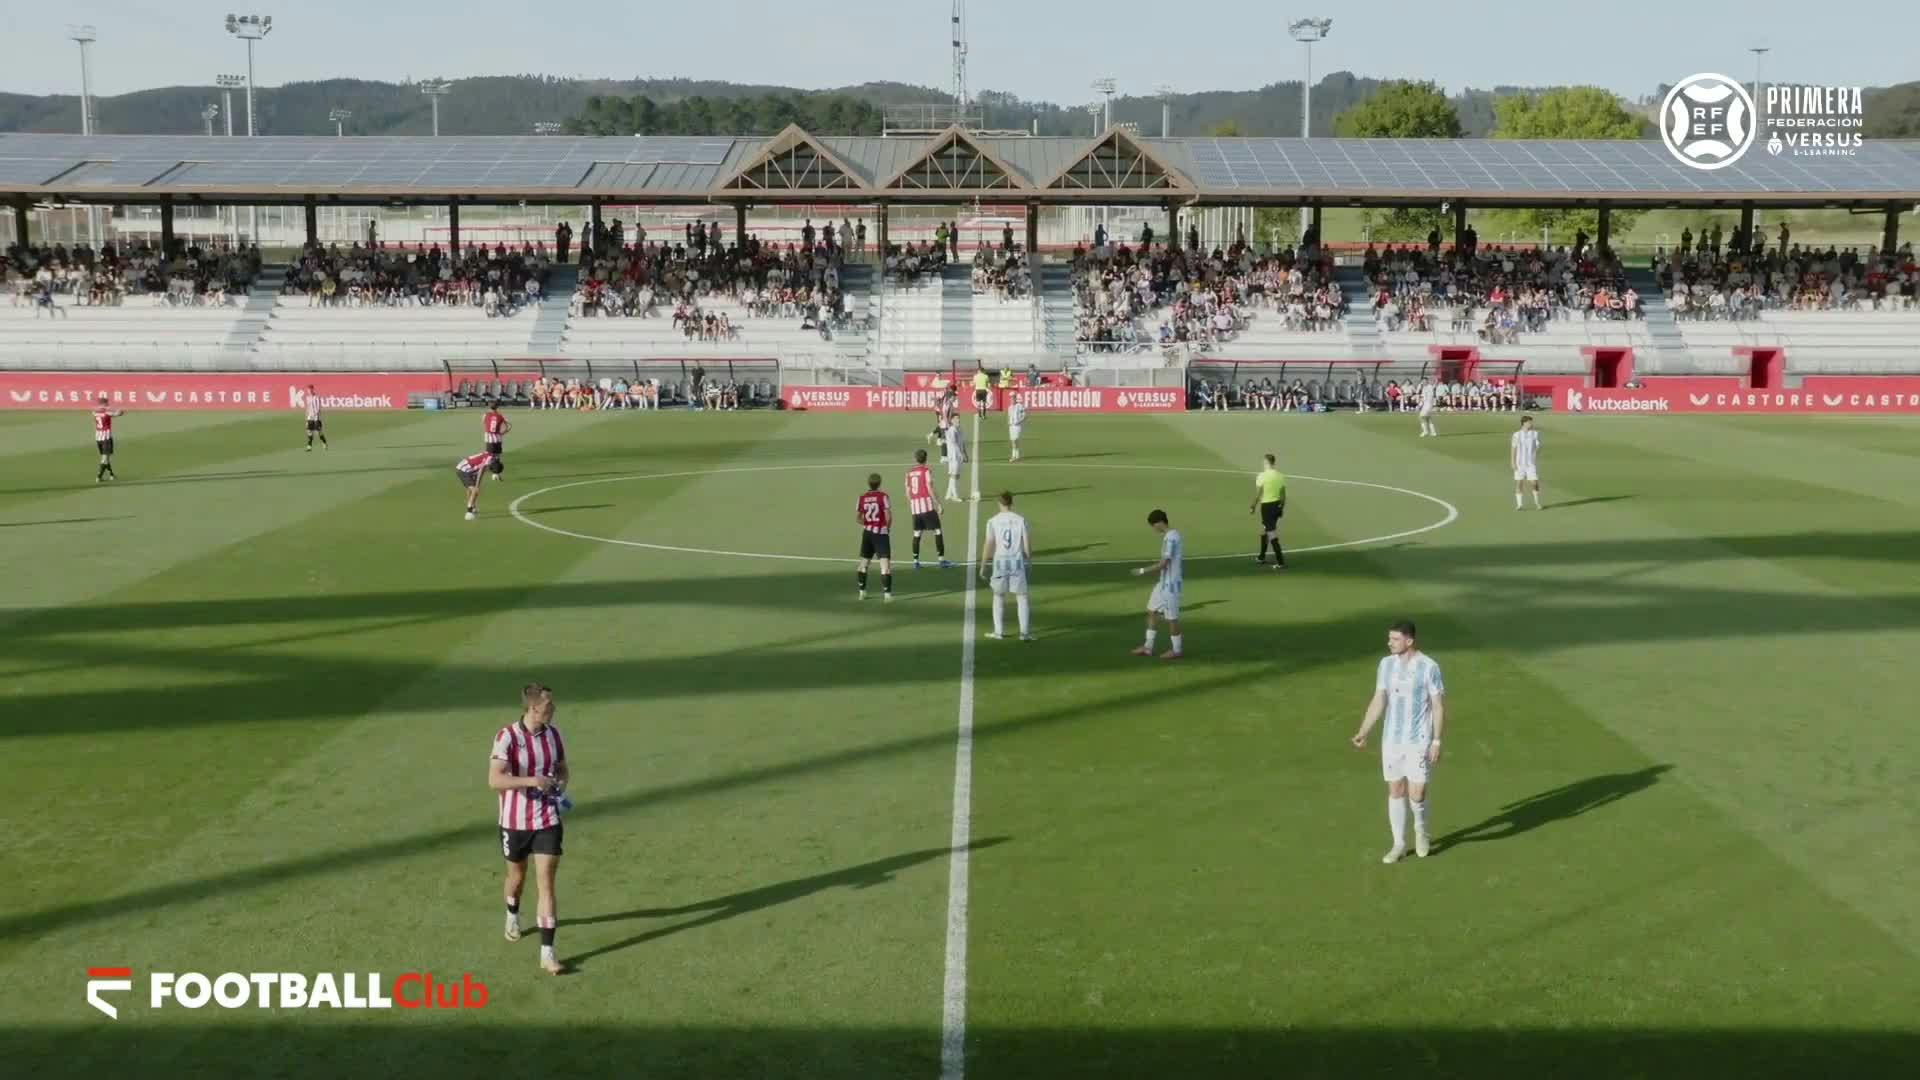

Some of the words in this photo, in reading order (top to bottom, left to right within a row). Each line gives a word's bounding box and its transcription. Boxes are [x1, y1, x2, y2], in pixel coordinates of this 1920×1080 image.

[39, 391, 137, 402] CASTORE
[173, 391, 272, 402] CASTORE
[306, 394, 392, 408] utxabank
[802, 391, 850, 401] VERSUS
[1128, 391, 1177, 402] VERSUS
[1717, 394, 1813, 406] CASTORE
[1588, 397, 1669, 410] kutxabank
[863, 502, 880, 521] 22
[1003, 528, 1012, 549] 9
